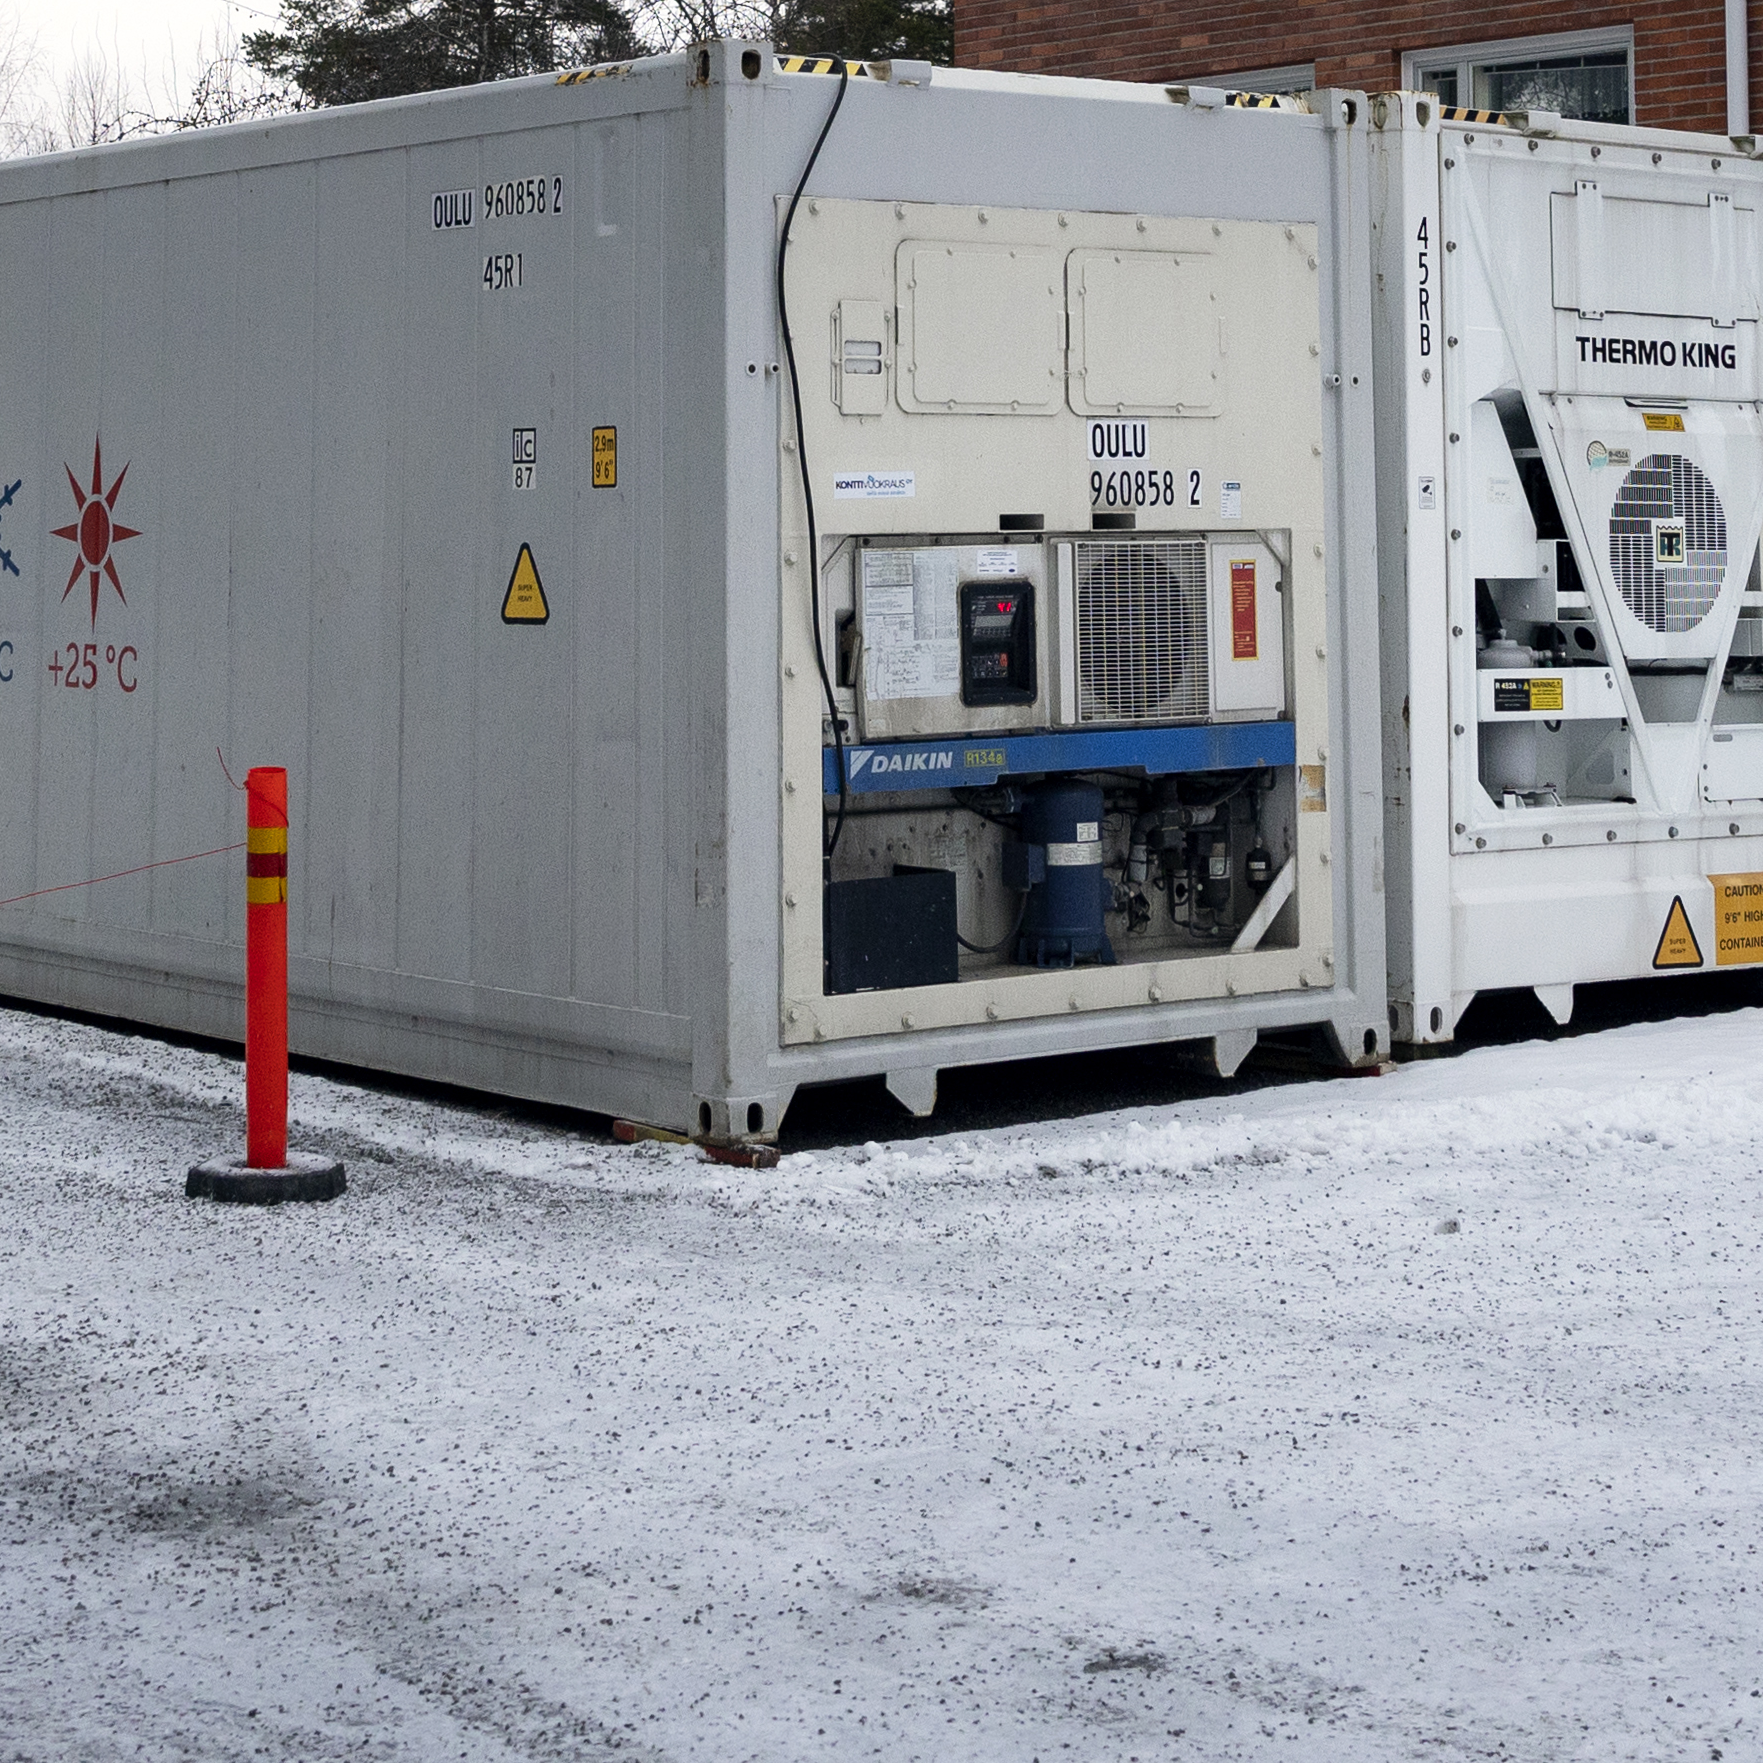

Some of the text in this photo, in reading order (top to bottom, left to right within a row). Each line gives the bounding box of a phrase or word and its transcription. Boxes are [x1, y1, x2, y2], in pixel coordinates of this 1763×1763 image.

[434, 177, 562, 228] OULU 960858 2
[484, 253, 522, 290] 45R1
[1417, 216, 1431, 356] 45RB
[1575, 336, 1736, 369] THERMO KING
[1092, 423, 1146, 458] OULU
[515, 467, 533, 488] 87
[1091, 470, 1174, 506] 960858
[1190, 470, 1200, 505] 2
[871, 751, 1003, 774] DAIKIN R134a
